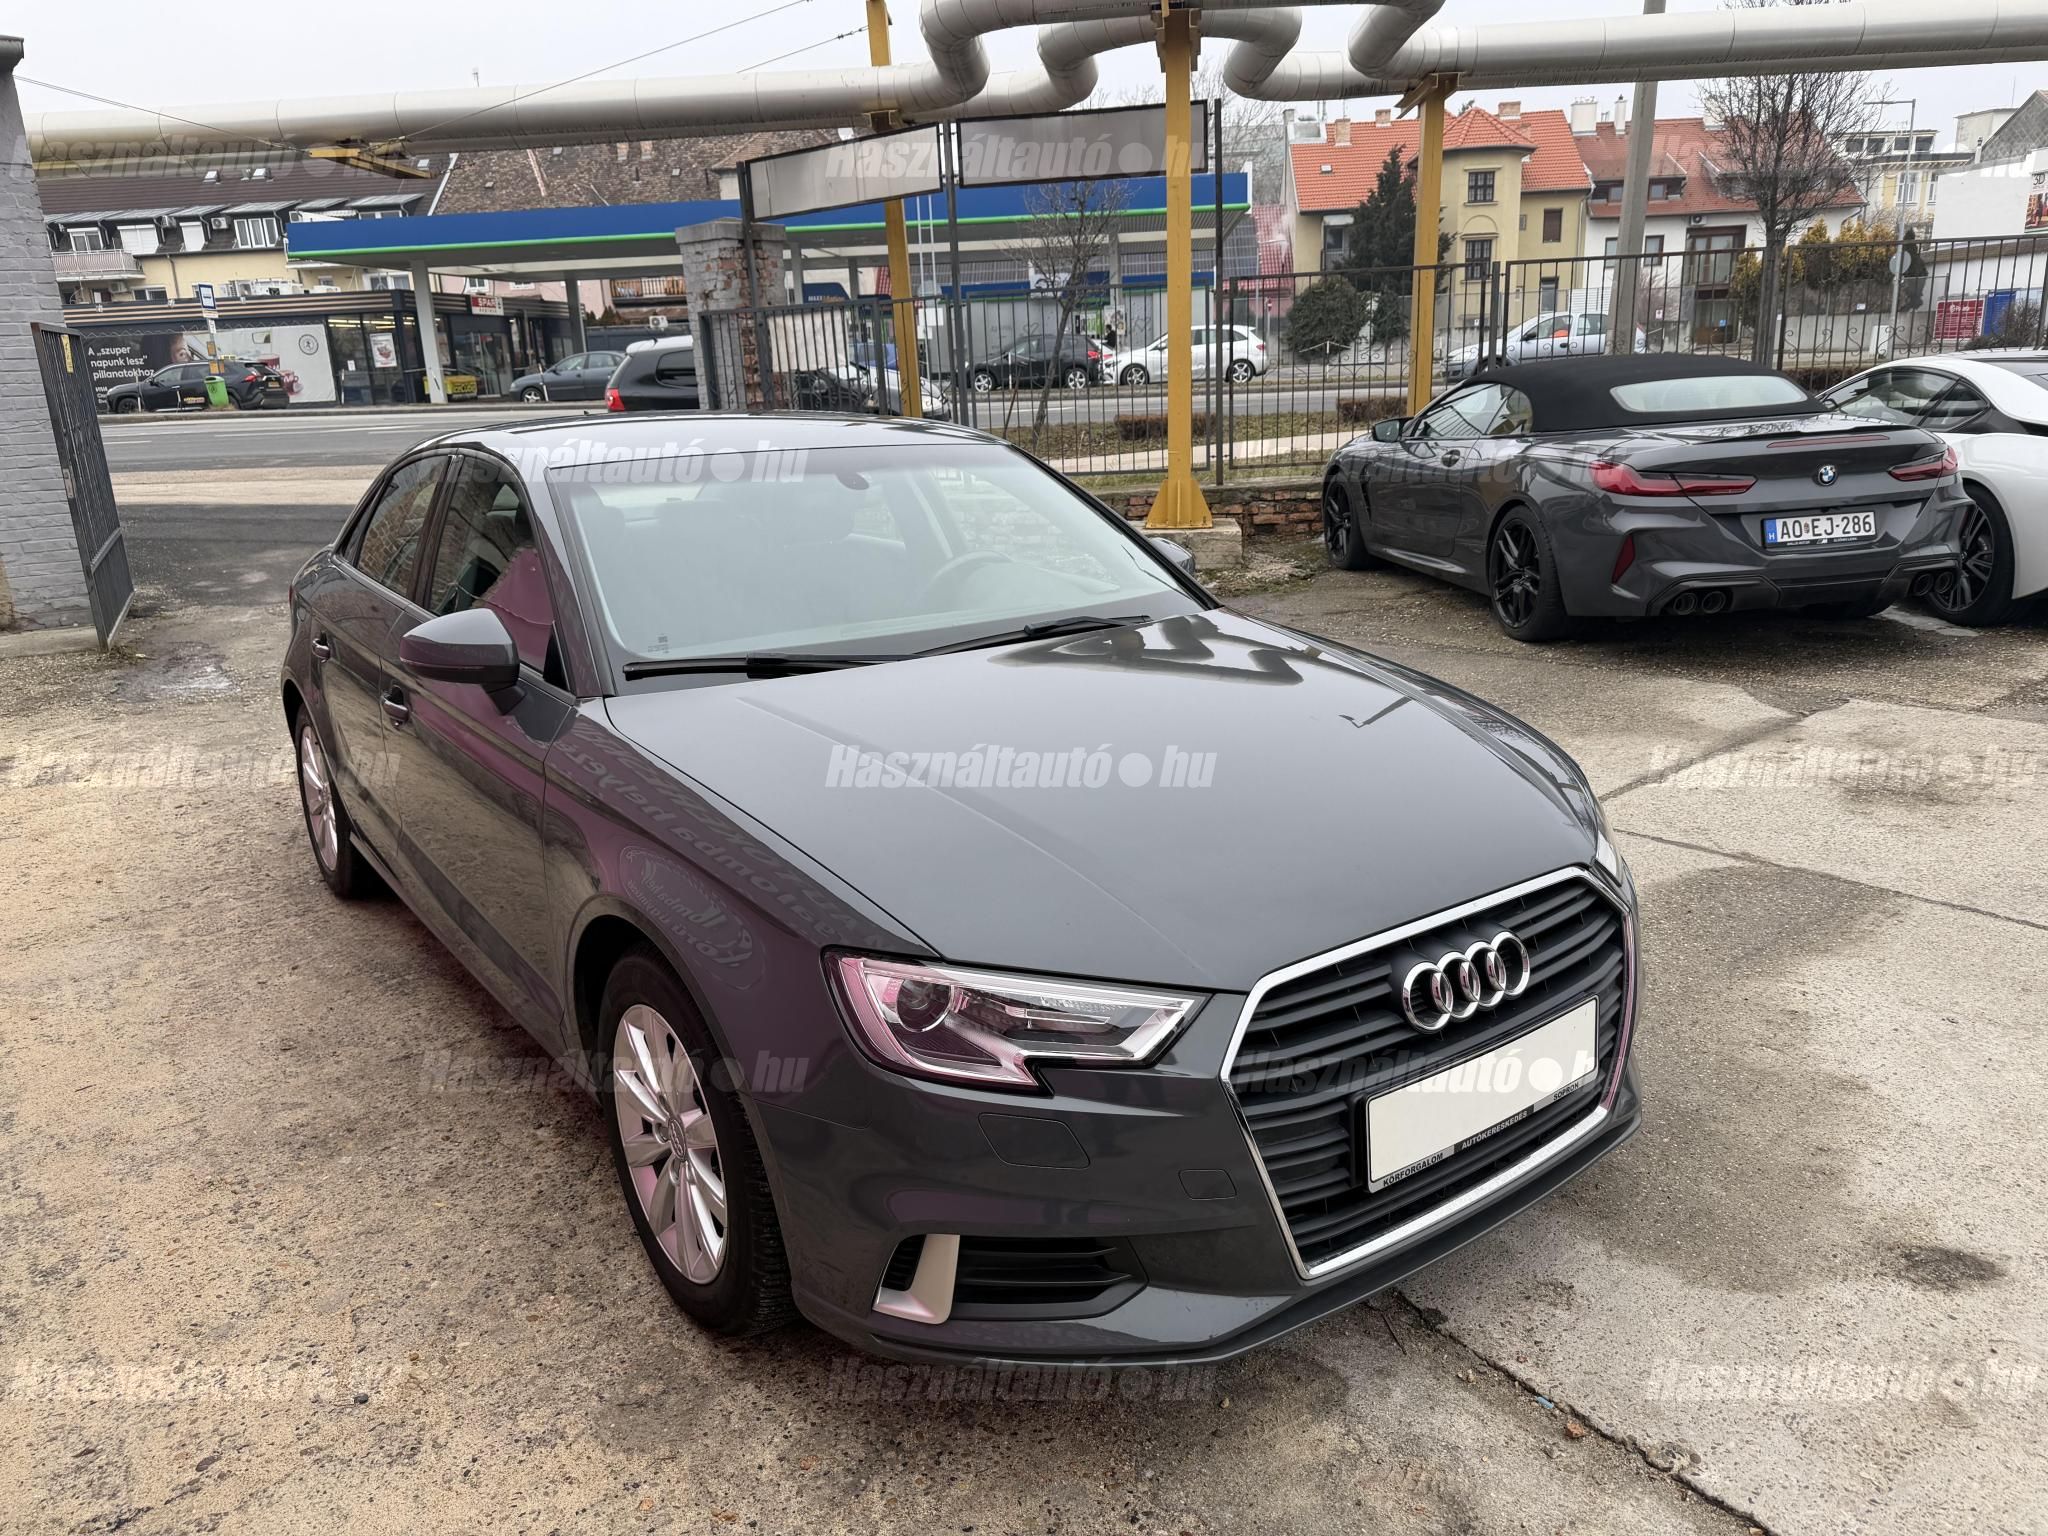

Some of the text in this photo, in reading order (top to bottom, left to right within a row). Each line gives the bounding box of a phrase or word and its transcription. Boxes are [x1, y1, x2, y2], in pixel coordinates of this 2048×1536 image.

[478, 297, 497, 308] SPAR
[88, 346, 95, 356] A
[91, 358, 125, 369] napunk
[1383, 1081, 1579, 1187] KÖRFORGALOM AUTÓKERESKEDÉS SOPRON
